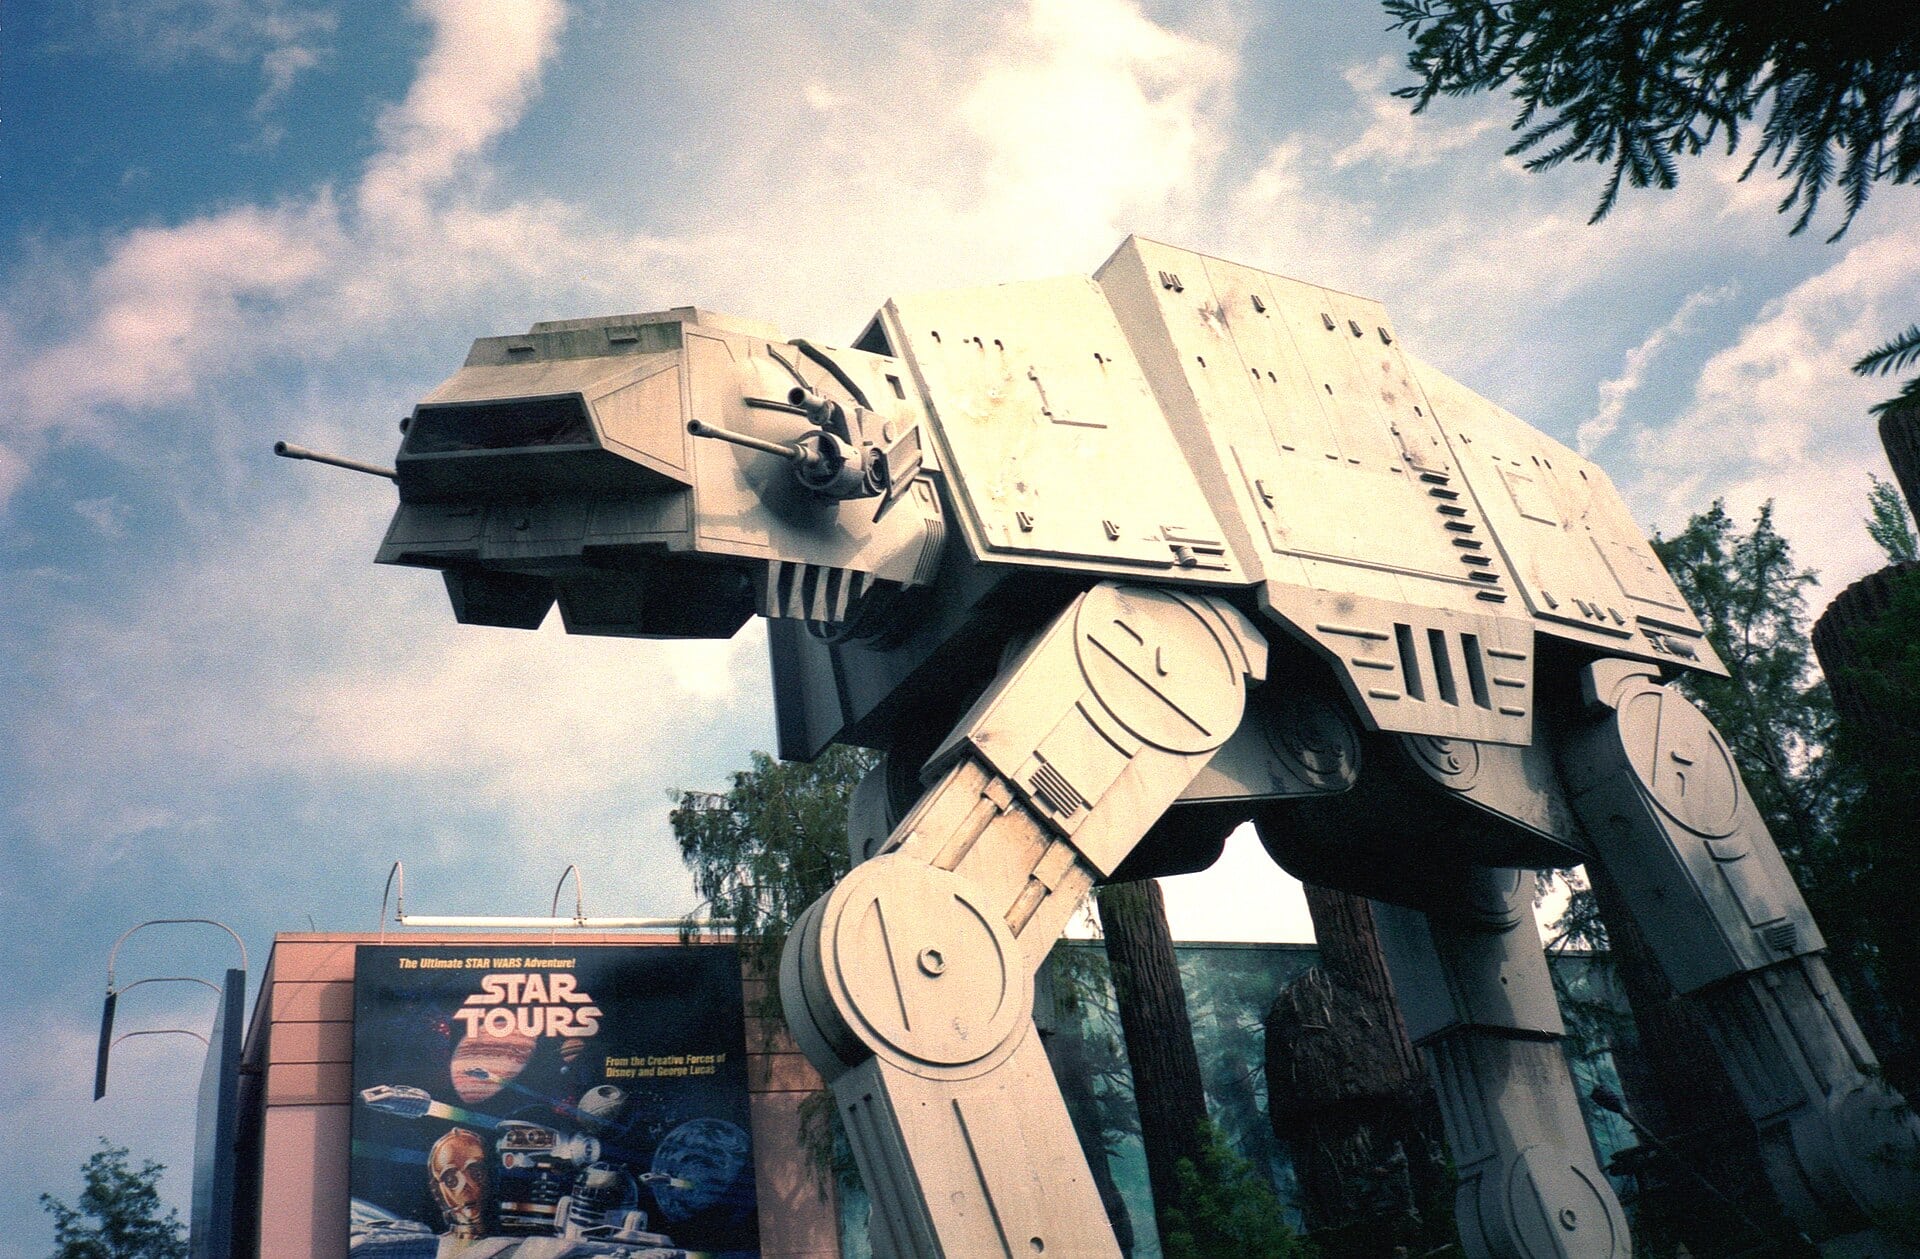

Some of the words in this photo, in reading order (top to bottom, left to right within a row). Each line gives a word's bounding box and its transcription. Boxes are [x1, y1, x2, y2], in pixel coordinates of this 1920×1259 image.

[399, 957, 418, 969] The
[420, 957, 463, 969] Ultimate
[465, 957, 490, 969] STAR
[492, 957, 522, 968] WARS
[524, 957, 576, 968] Adventure!
[464, 973, 593, 1004] STAR
[453, 1006, 603, 1038] TOURS
[606, 1056, 628, 1066] From
[631, 1056, 645, 1066] the
[648, 1055, 684, 1065] Creative
[686, 1054, 715, 1064] Forces
[716, 1053, 726, 1063] of
[606, 1067, 636, 1078] Disney
[638, 1067, 655, 1076] and
[657, 1066, 688, 1077] George
[690, 1065, 716, 1075] Lucas
